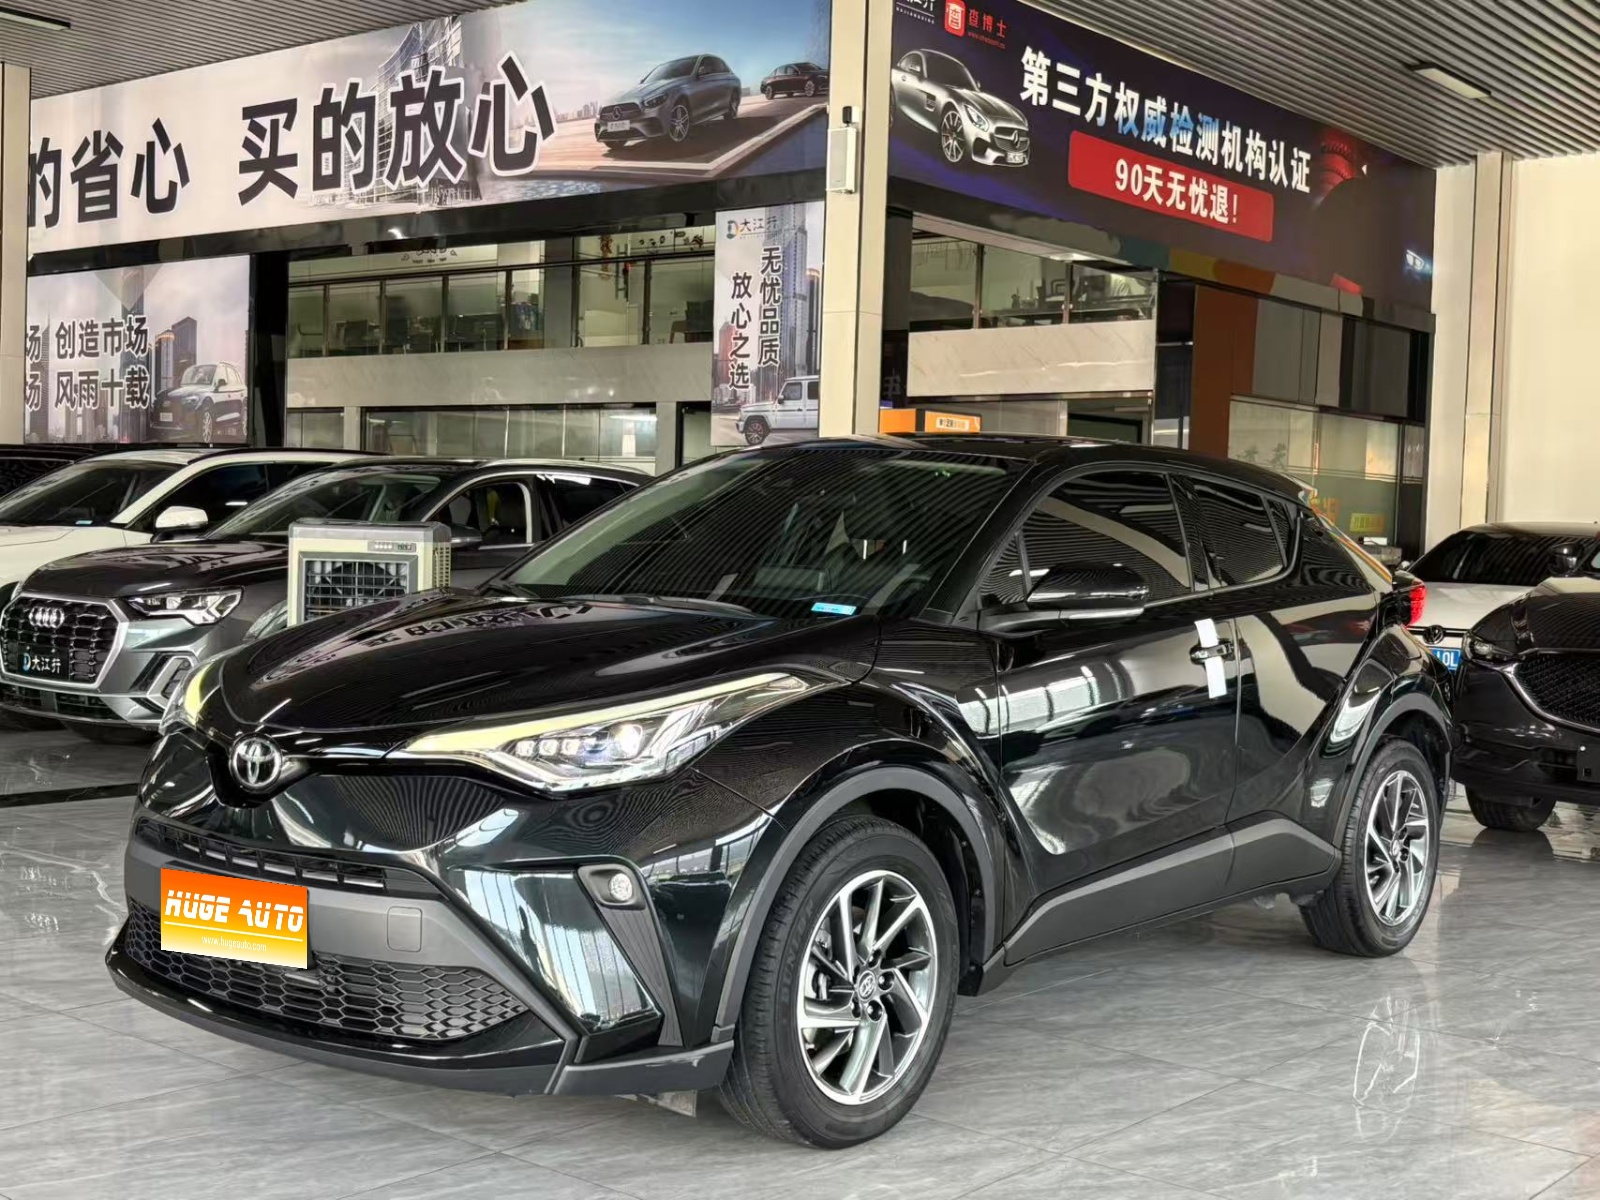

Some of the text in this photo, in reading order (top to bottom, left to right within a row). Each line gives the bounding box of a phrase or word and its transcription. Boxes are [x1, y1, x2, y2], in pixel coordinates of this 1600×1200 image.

[29, 54, 556, 229] 的省心 买的放心
[1020, 46, 1311, 193] 第三方权威检测机构认证
[740, 216, 778, 232] 大江行
[1115, 159, 1238, 224] 90天无忧退!
[55, 317, 148, 359] 创造市场
[728, 272, 753, 390] 放心之选
[758, 246, 782, 366] 无忧品质
[55, 367, 149, 409] 风雨十载
[32, 655, 61, 673] 大江行
